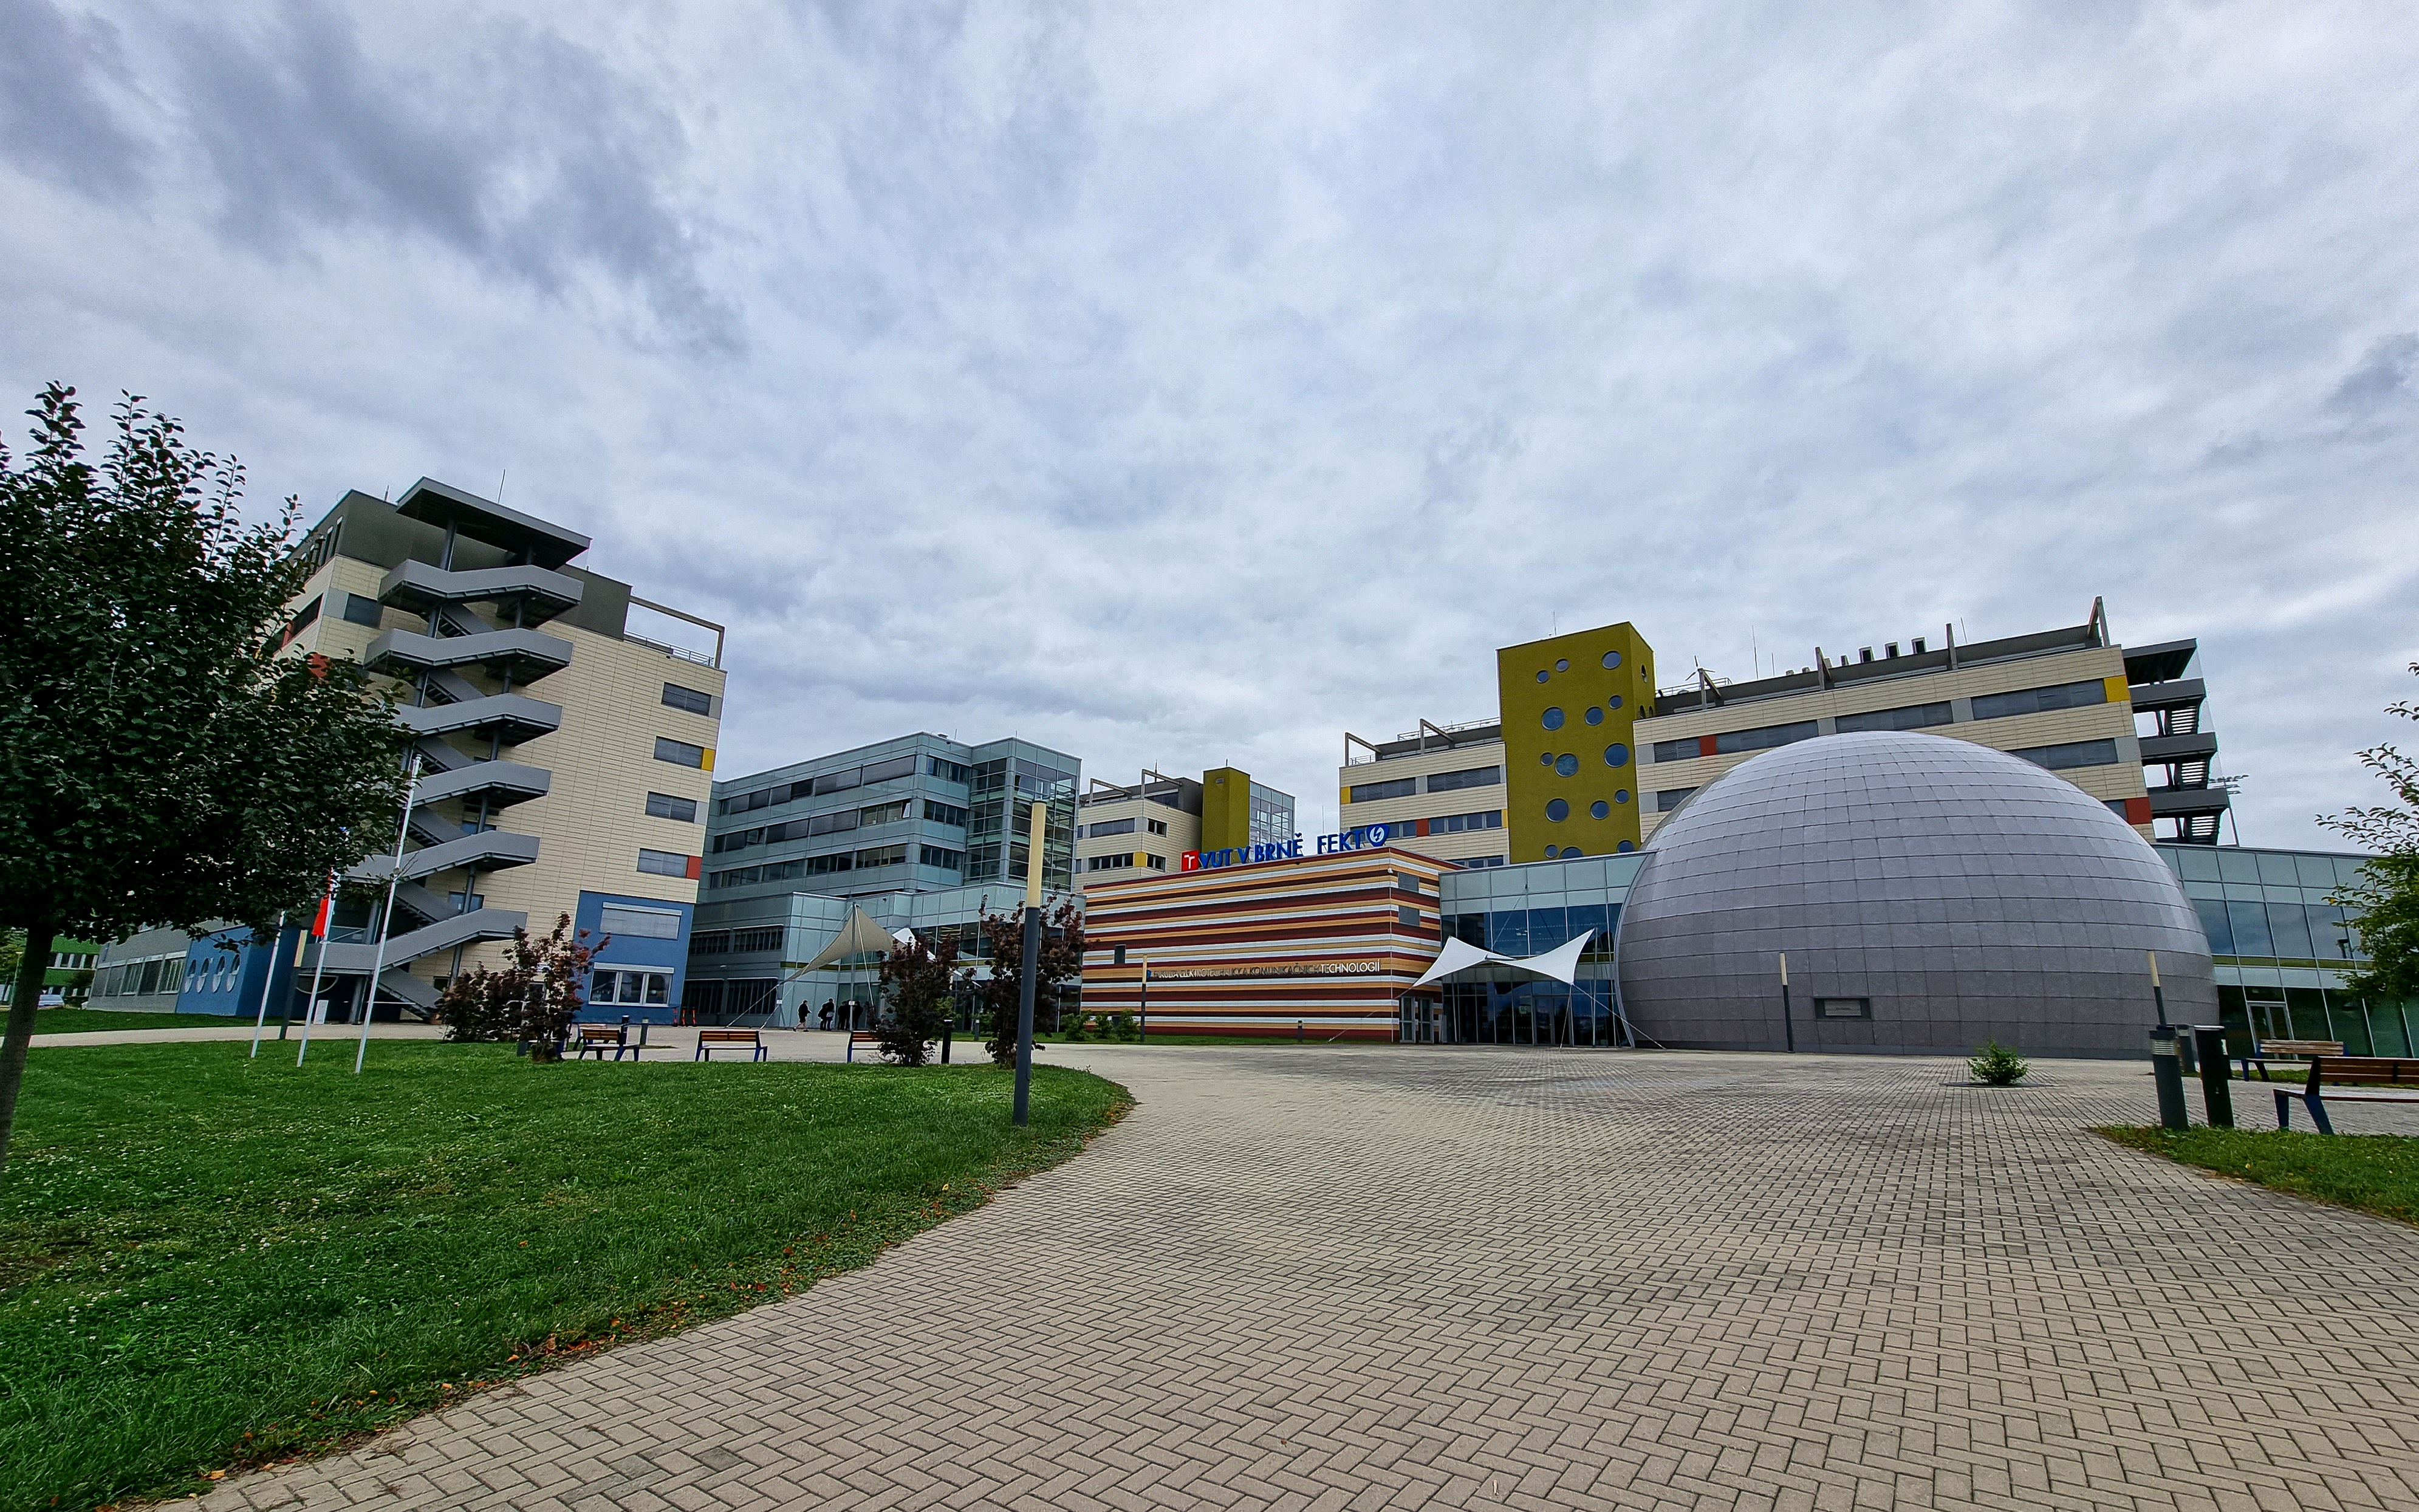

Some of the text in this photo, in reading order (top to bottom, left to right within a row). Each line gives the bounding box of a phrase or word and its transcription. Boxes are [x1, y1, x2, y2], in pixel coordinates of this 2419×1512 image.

[1199, 849, 1233, 869] VUT
[1237, 846, 1251, 864] V
[1254, 833, 1303, 862] BRNĚ
[1317, 830, 1364, 854] FEKT
[1321, 959, 1380, 973] TECHNOLOGIÍ
